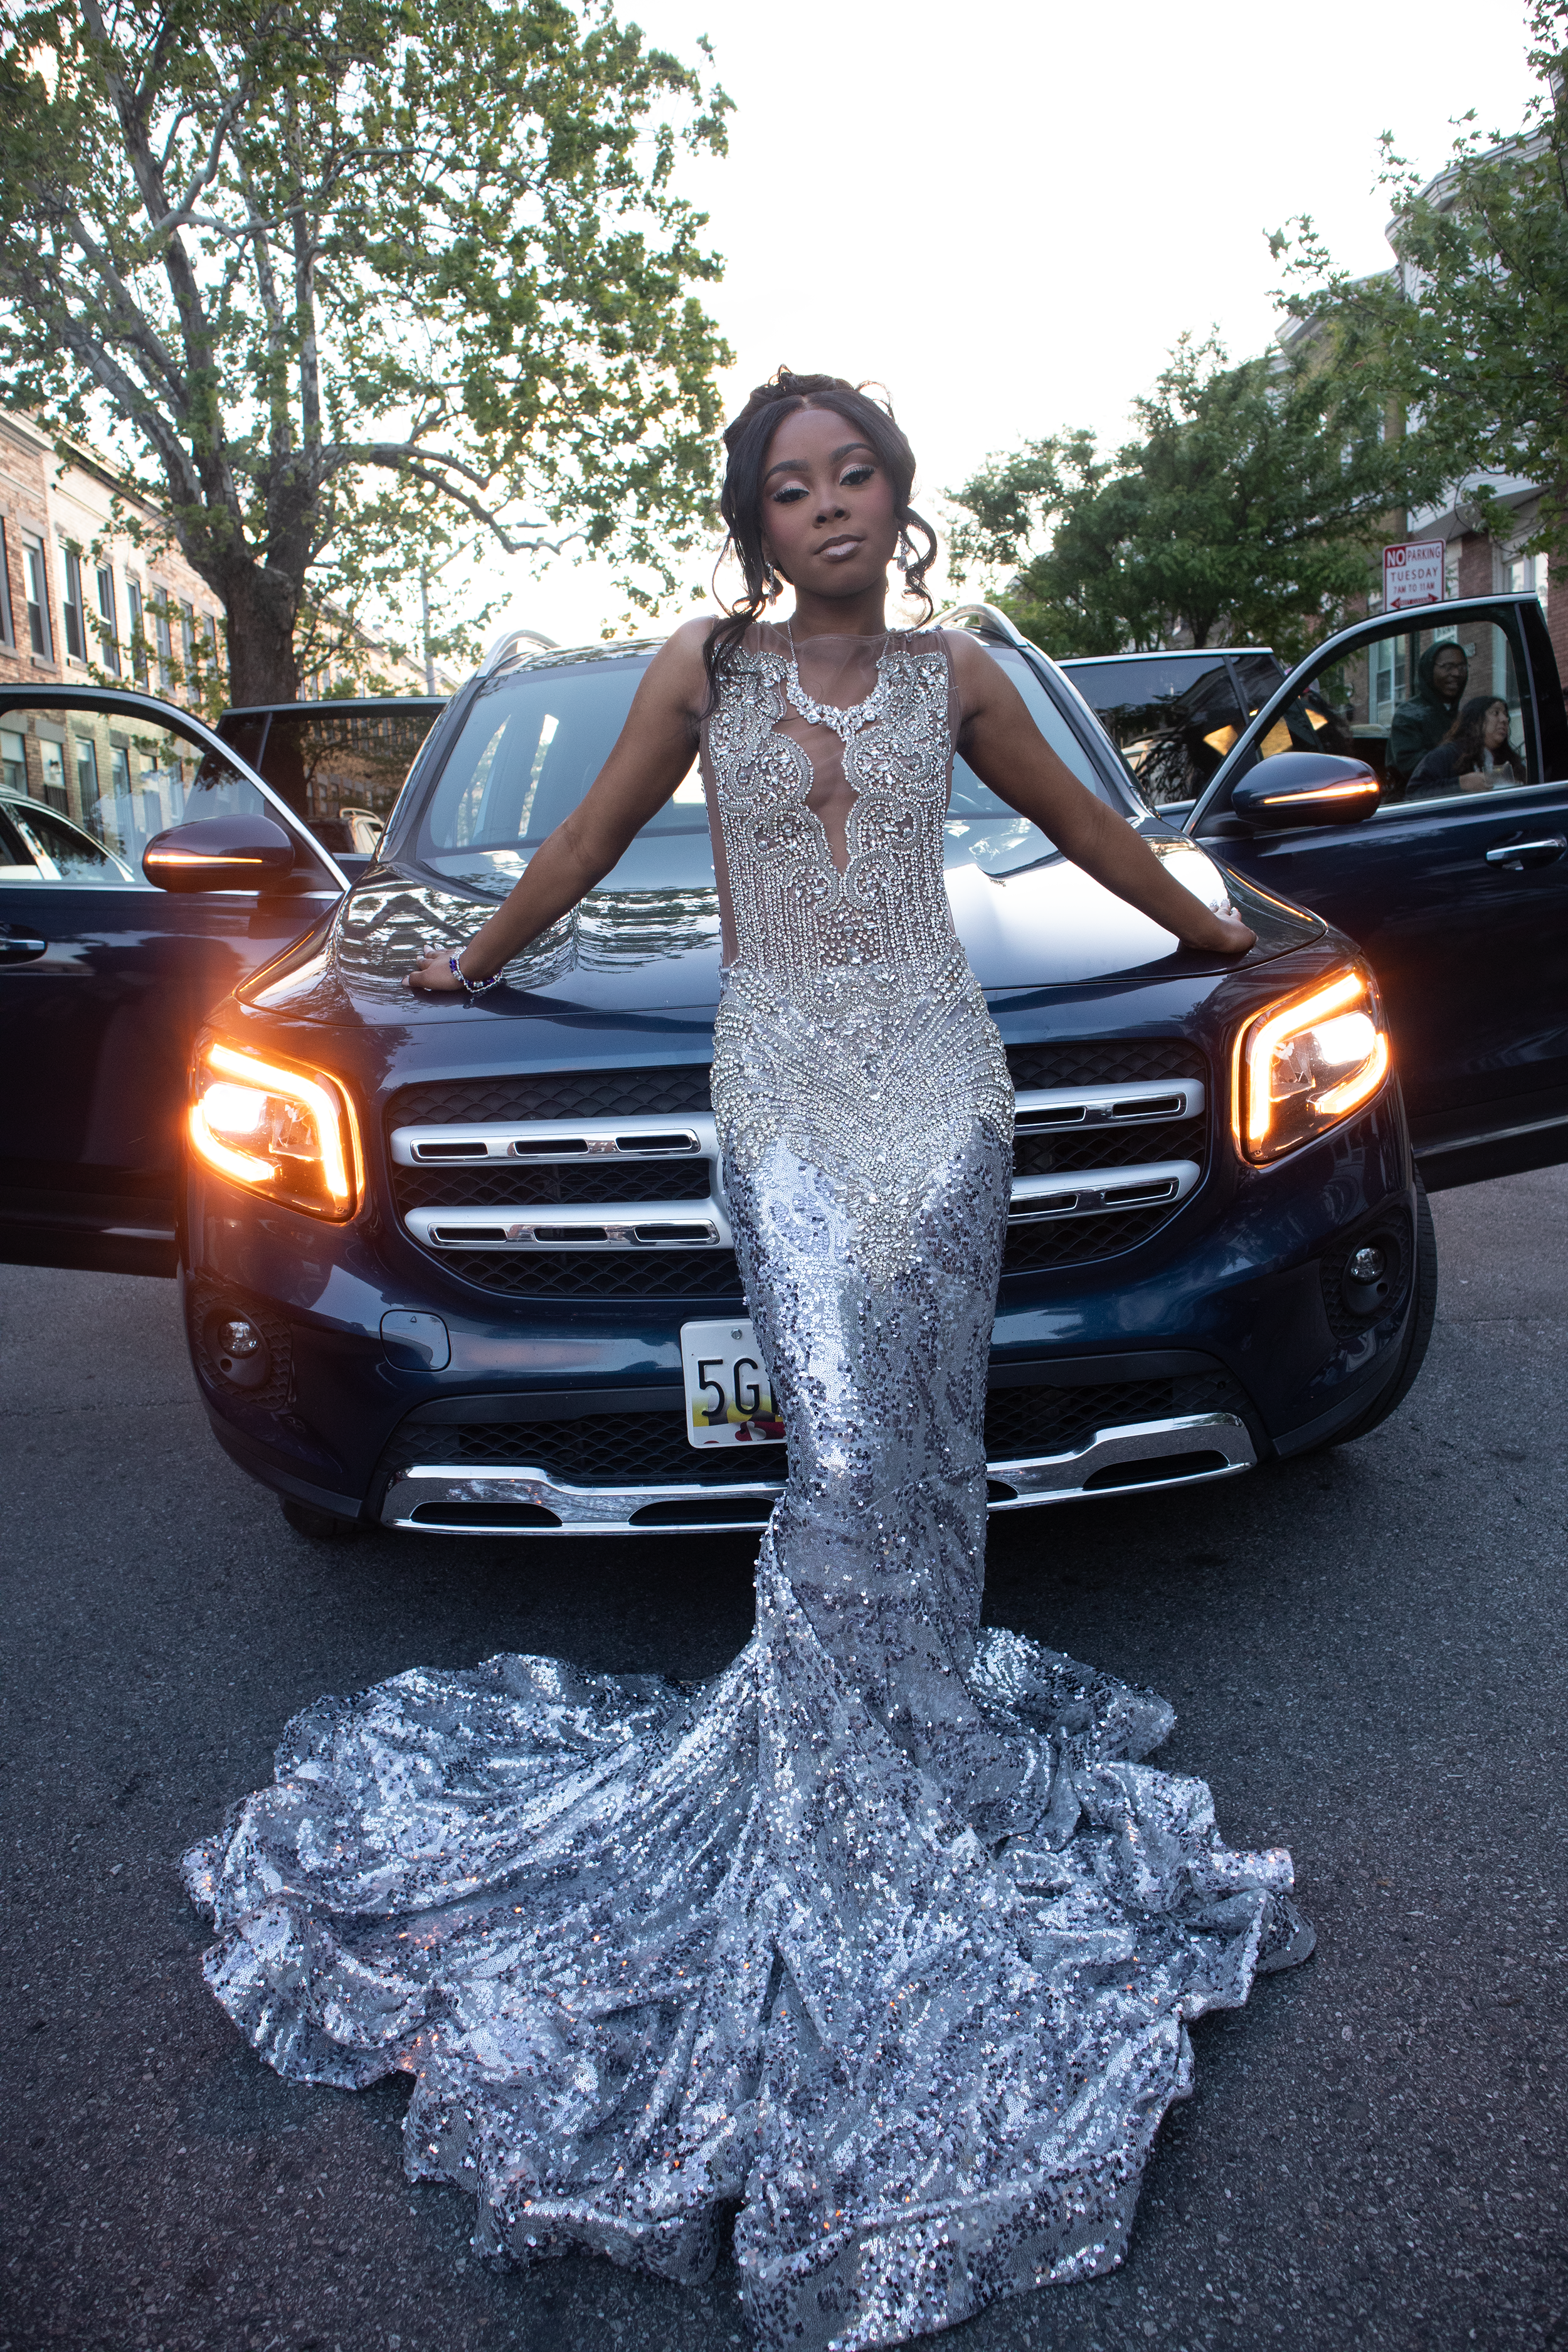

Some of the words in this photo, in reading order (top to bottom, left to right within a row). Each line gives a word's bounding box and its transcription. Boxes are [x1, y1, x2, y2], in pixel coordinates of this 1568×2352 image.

[1387, 549, 1406, 567] NO
[1407, 546, 1441, 561] PARKING
[1391, 566, 1438, 582] TUESDAY
[1394, 585, 1406, 594] 7AM
[1409, 583, 1417, 592] TO
[1420, 582, 1435, 591] 11AM
[697, 1357, 780, 1416] 5G
